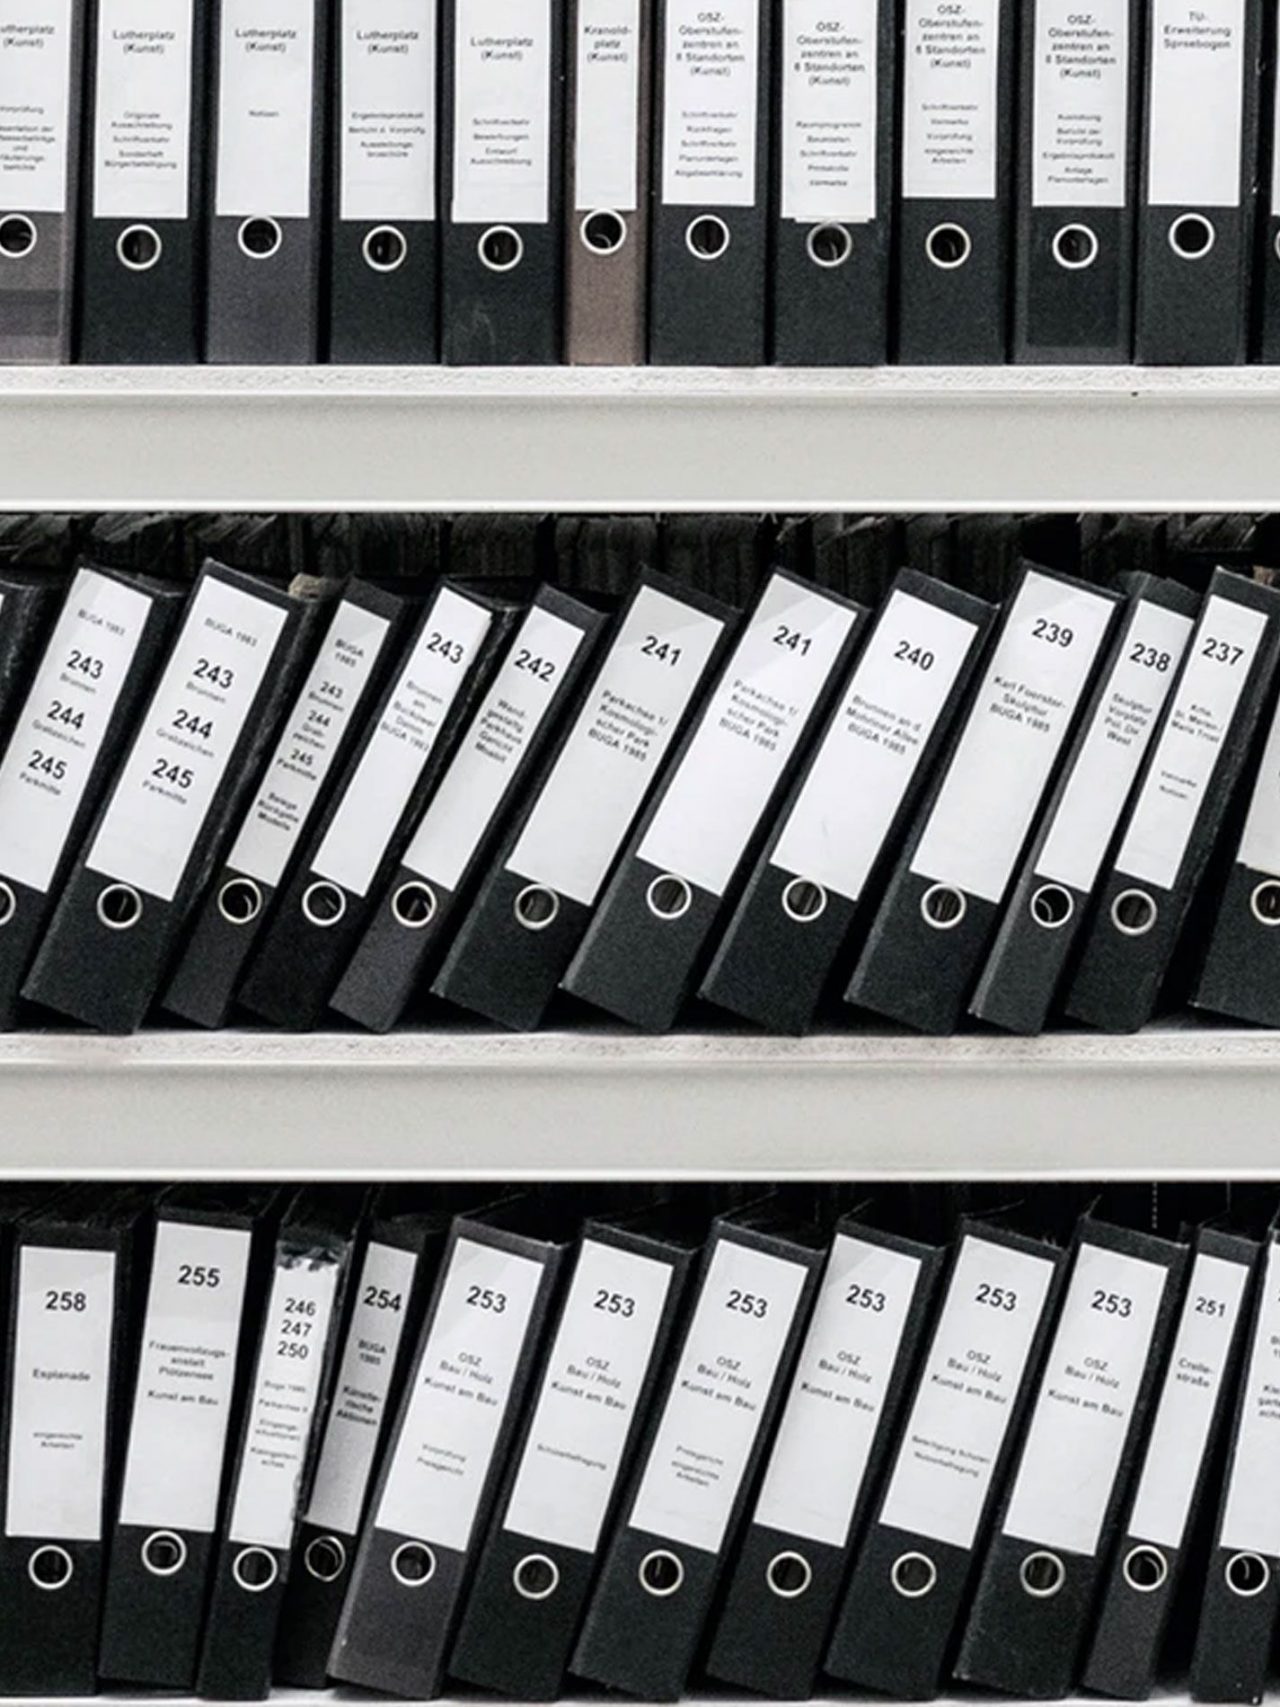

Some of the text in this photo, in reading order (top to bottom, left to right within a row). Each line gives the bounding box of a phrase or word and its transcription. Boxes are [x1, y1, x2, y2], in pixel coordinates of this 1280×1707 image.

[111, 29, 176, 43] Lutherplatz
[234, 28, 298, 41] Lutherplatz
[355, 29, 420, 42] Lutherplatz
[678, 24, 742, 36] Oberstufen-
[1162, 23, 1233, 39] Erweiterung
[122, 42, 165, 55] (Kunst)
[244, 41, 287, 54] (Kunst)
[367, 43, 409, 56] (Kunst)
[469, 36, 534, 49] Lutherplatz
[593, 38, 622, 51] platz
[682, 40, 723, 50] zentren
[480, 49, 524, 62] (Kunst)
[586, 52, 629, 64] (Kunst)
[685, 52, 745, 63] Standorten
[689, 66, 732, 78] (Kunst)
[772, 625, 812, 656] 241
[1031, 618, 1074, 648] 239
[426, 632, 464, 664] 243
[640, 635, 682, 666] 241
[893, 640, 935, 671] 240
[1129, 642, 1172, 673] 238
[1201, 637, 1245, 666] 237
[66, 649, 104, 680] 243
[193, 658, 234, 690] 243
[513, 648, 556, 683] 242
[320, 681, 343, 699] 243
[46, 700, 85, 730] 244
[307, 710, 331, 727] 244
[988, 702, 1024, 723] BUGA
[172, 708, 214, 740] 244
[27, 749, 67, 780] 245
[290, 749, 313, 766] 245
[151, 758, 194, 789] 245
[177, 1264, 221, 1288] 255
[45, 1290, 87, 1312] 258
[284, 1297, 316, 1317] 246
[363, 1285, 402, 1313] 254
[466, 1285, 507, 1314] 253
[593, 1289, 636, 1318] 253
[725, 1289, 768, 1319] 253
[845, 1283, 886, 1313] 253
[975, 1283, 1017, 1312] 253
[1091, 1289, 1132, 1318] 253
[1195, 1296, 1226, 1317] 251
[281, 1319, 313, 1337] 247
[277, 1340, 309, 1360] 250
[31, 1367, 92, 1382] Esplanade
[585, 1355, 611, 1373] OSZ
[146, 1389, 219, 1406] Kunst am Bau
[550, 1380, 628, 1411] Kunst am Bau
